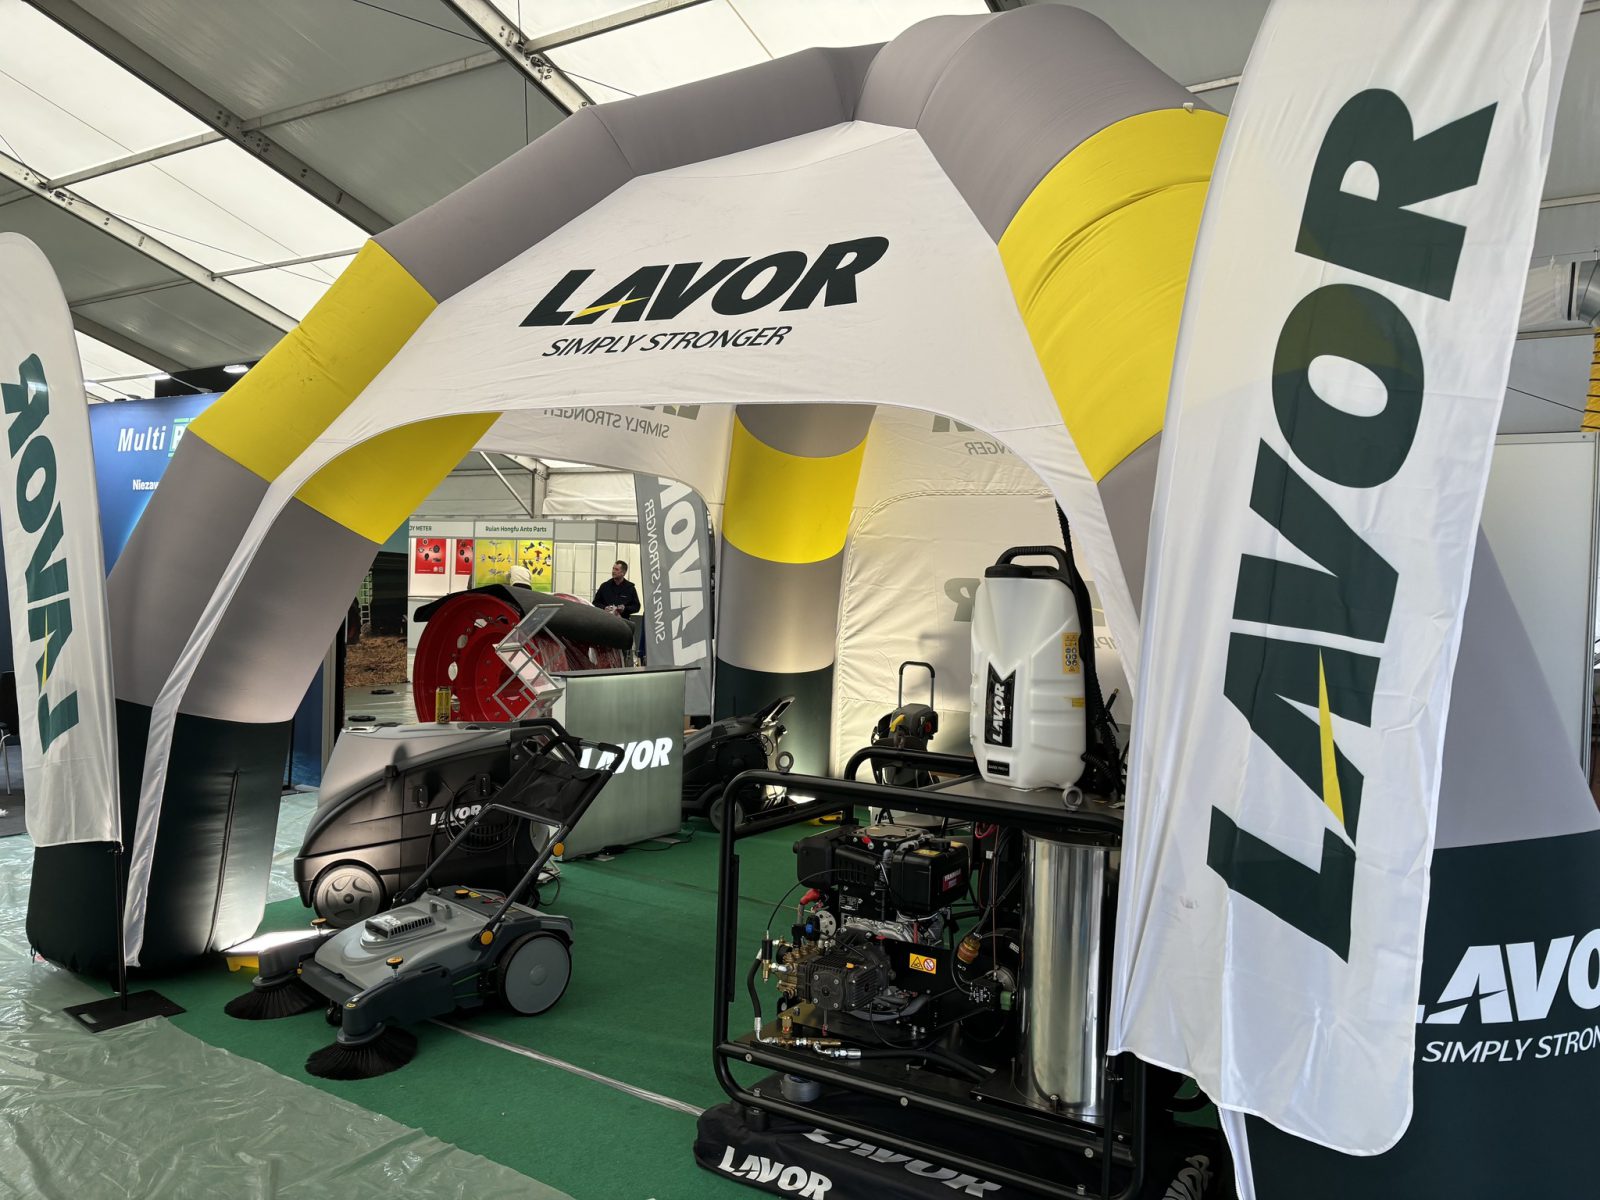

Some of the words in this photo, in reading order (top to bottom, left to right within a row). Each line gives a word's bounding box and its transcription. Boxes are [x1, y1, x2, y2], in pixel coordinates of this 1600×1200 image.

[519, 236, 889, 328] LAVOR
[542, 333, 646, 357] SIMPLY
[641, 326, 793, 352] STRONGER
[118, 426, 167, 452] Multi
[1207, 88, 1498, 963] LAVOR
[992, 682, 1005, 744] LAVOR
[1416, 928, 1600, 1024] AVO
[1422, 1038, 1533, 1063] SIMPLY
[718, 1145, 832, 1200] LAVOR
